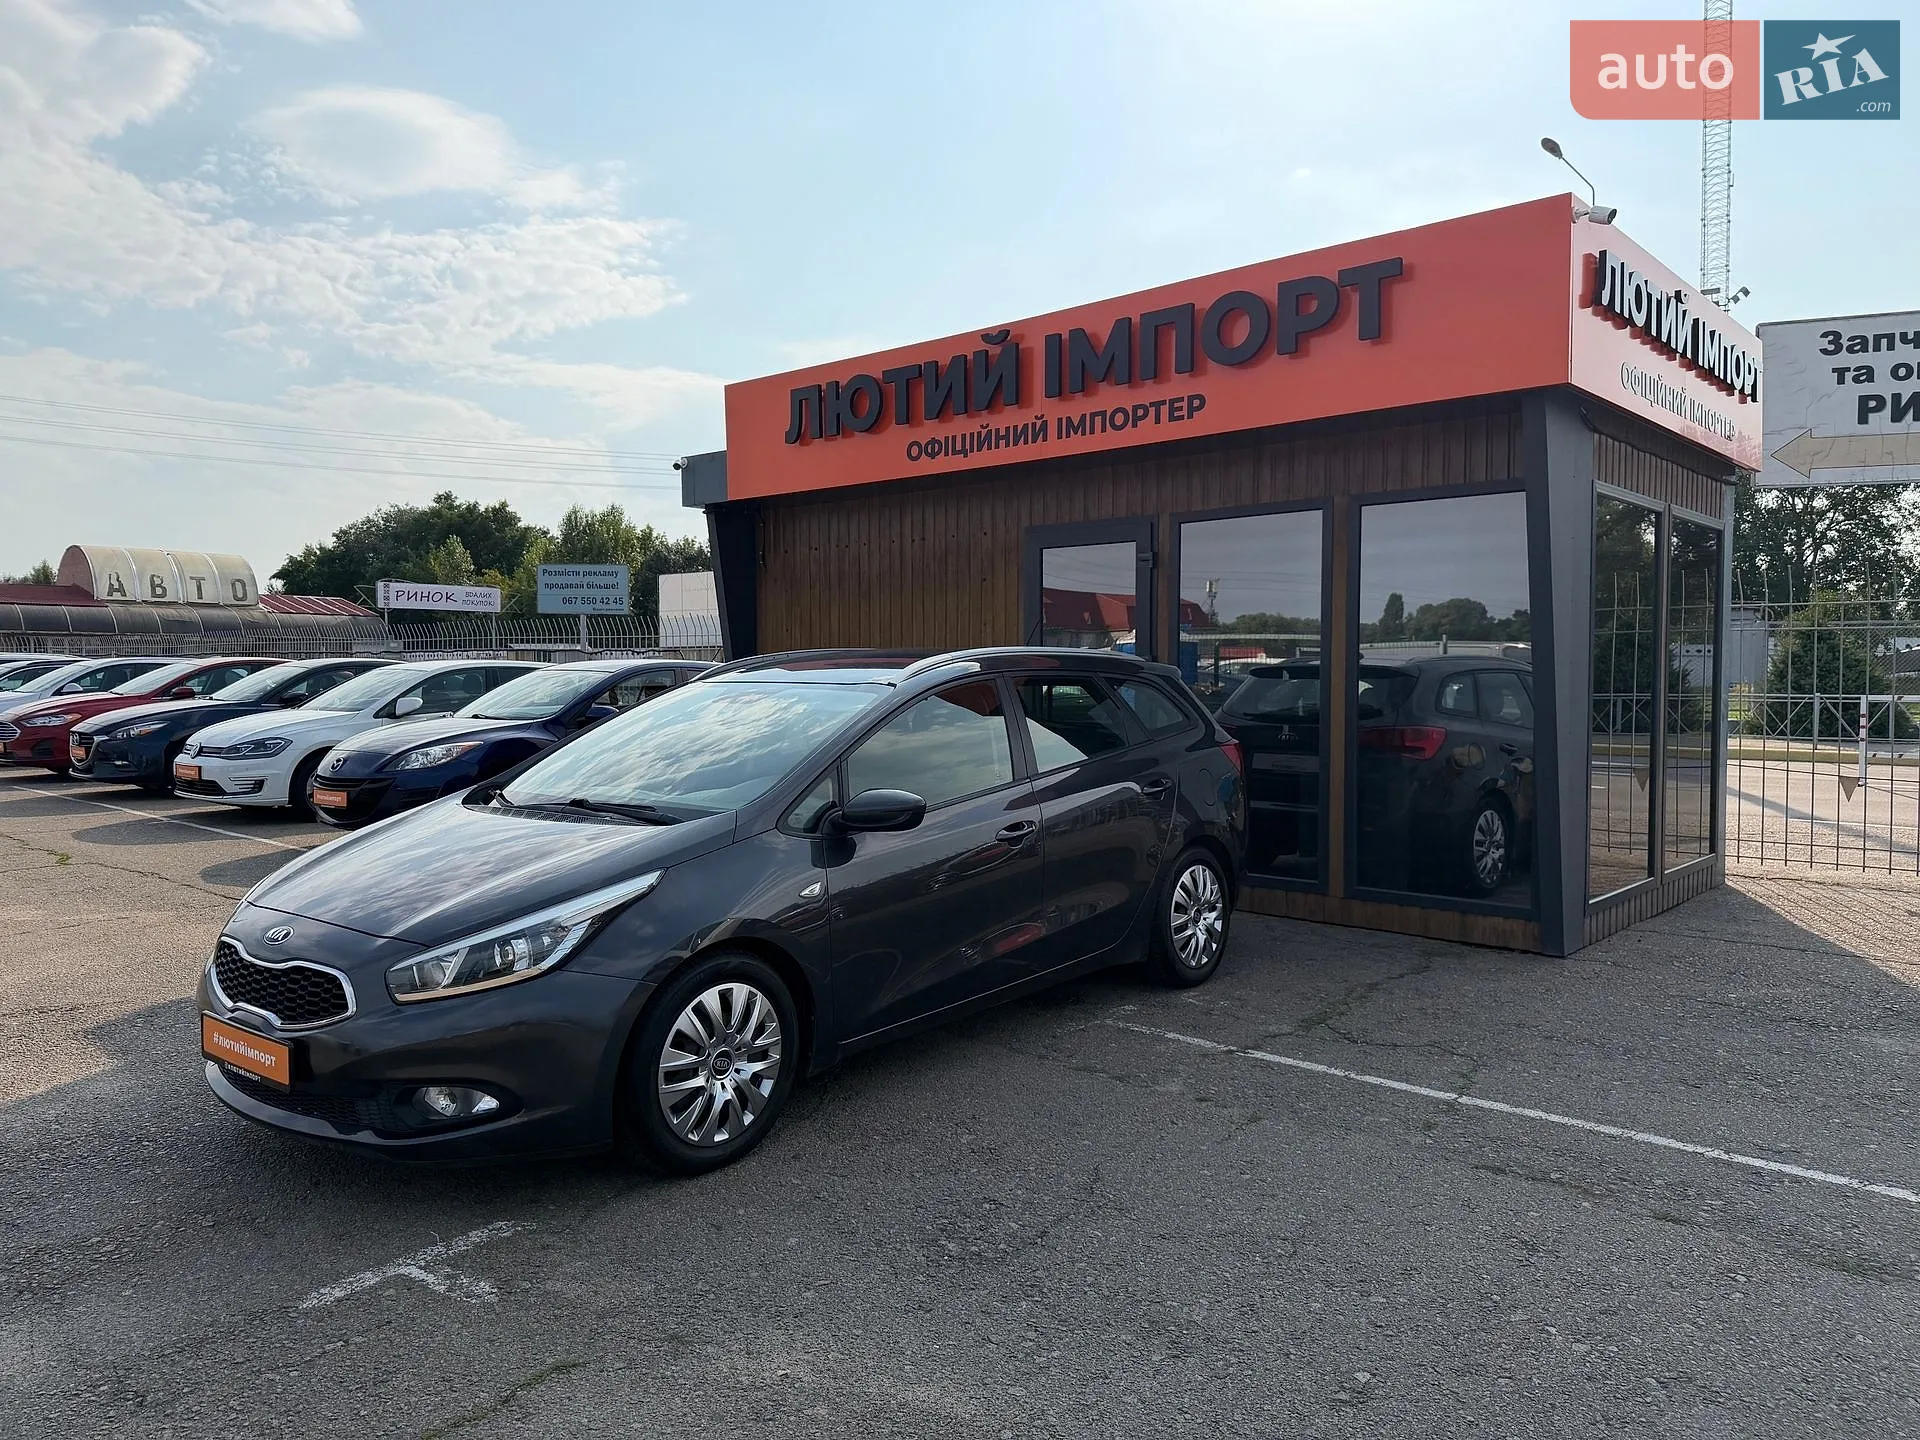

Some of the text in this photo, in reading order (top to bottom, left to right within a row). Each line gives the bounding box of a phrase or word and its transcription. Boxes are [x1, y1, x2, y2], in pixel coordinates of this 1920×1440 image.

[1596, 249, 1763, 403] ЛЮТИЙ ІМПОРТ
[784, 257, 1403, 446] ЛЮТИЙ ІМПОРТ
[1819, 330, 1920, 356] Запч
[1620, 361, 1690, 417] ОФІЦІЙНИЙ
[1832, 365, 1875, 385] та
[1857, 391, 1920, 425] РИ
[906, 394, 1206, 462] ОФІЦІЙНИЙ ІМПОРТЕР
[107, 571, 248, 602] АВТО
[542, 568, 619, 579] Розмісти рекламу
[544, 581, 619, 590] продавай більше!
[395, 590, 458, 603] РИНОК
[562, 597, 624, 605] 067 550 42 45
[213, 1031, 276, 1067] #лютийімпорт
[716, 1060, 729, 1068] KIA
